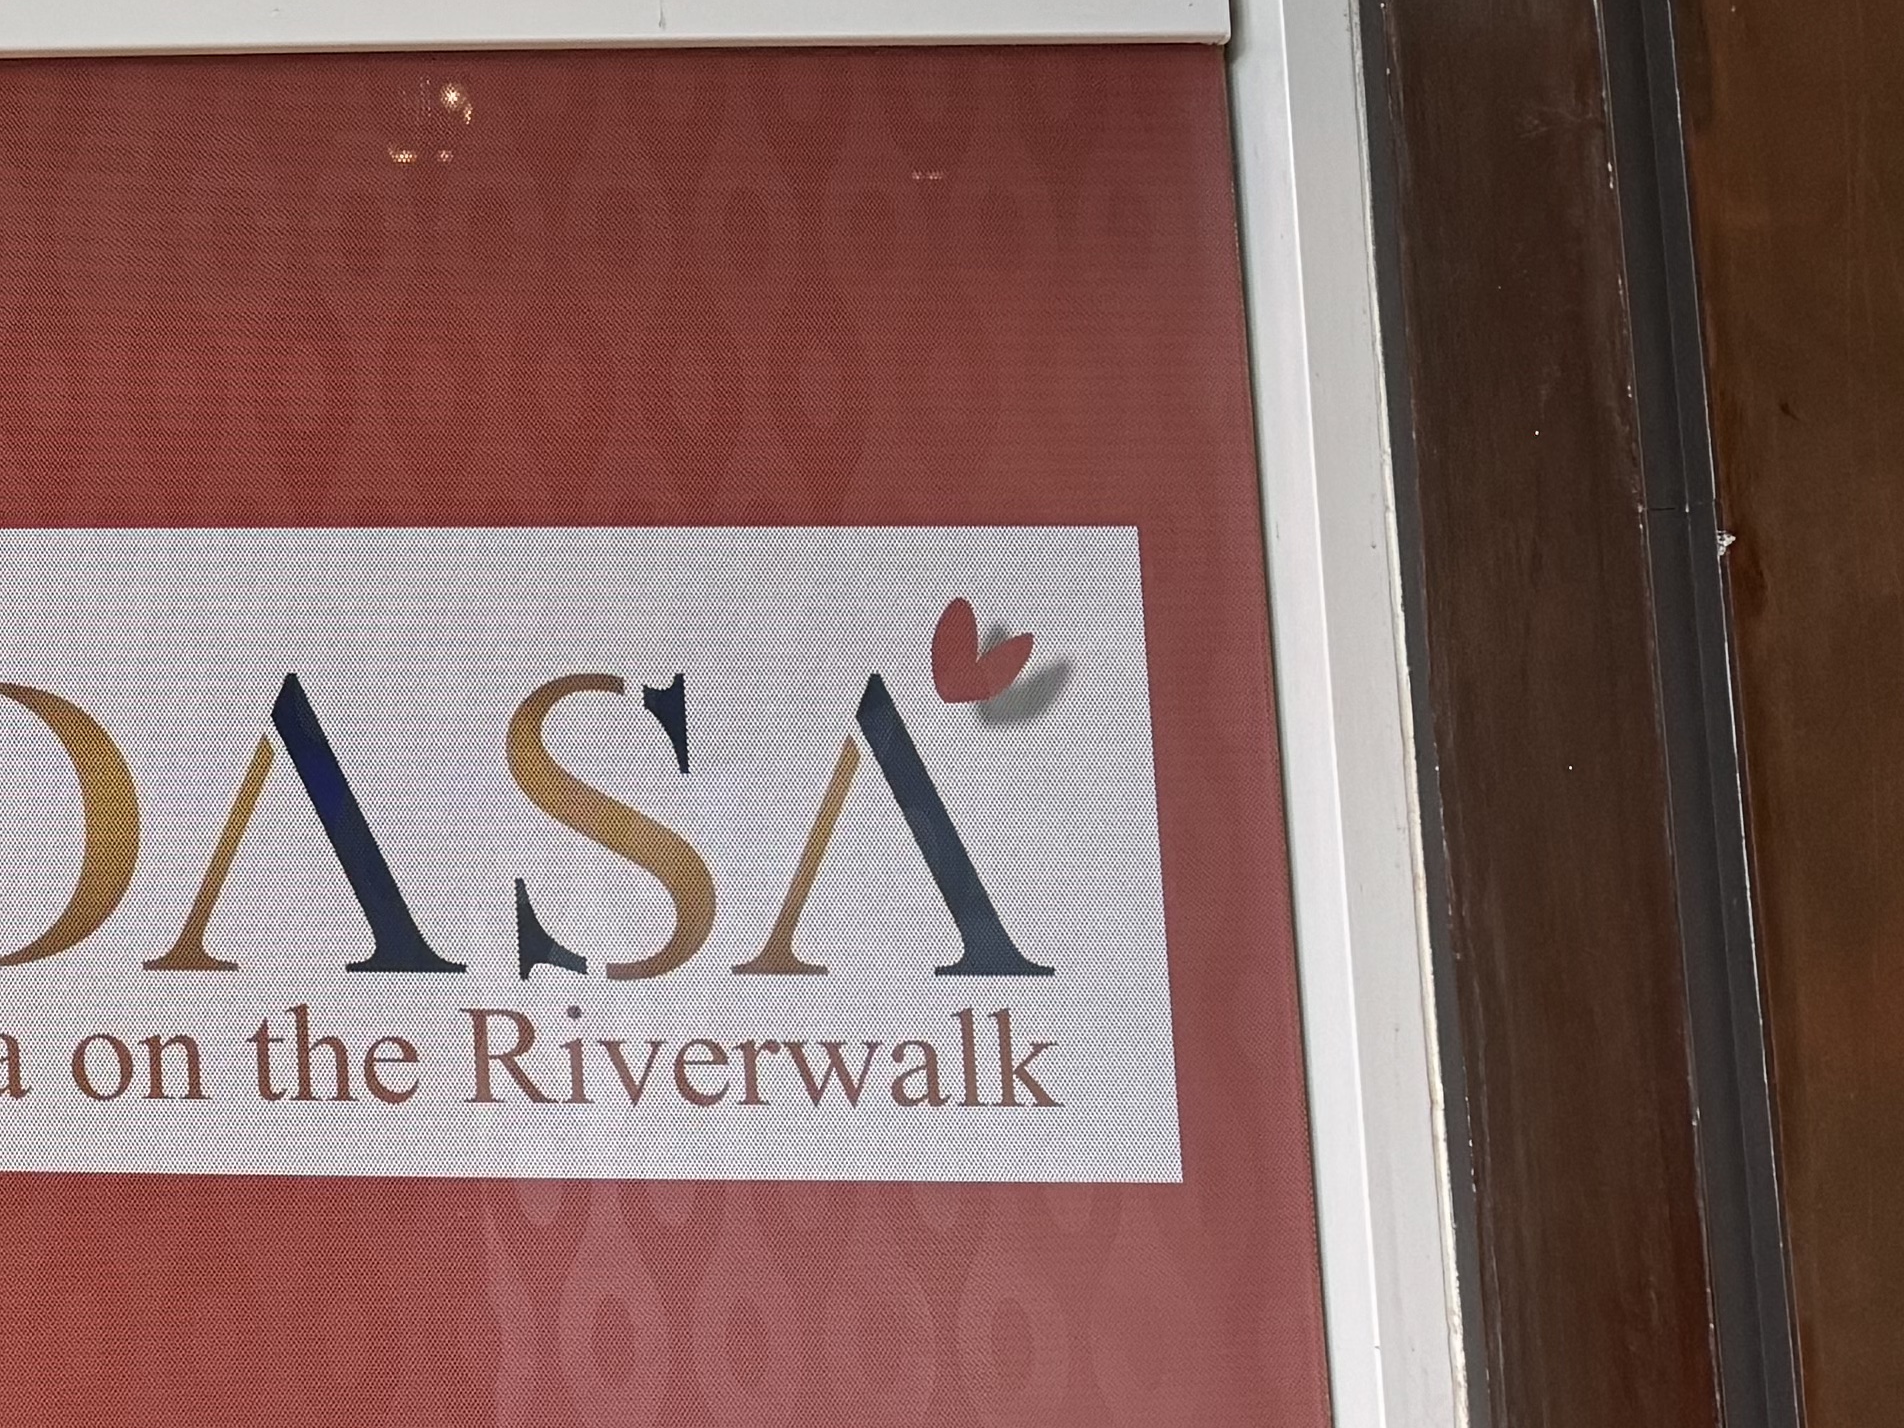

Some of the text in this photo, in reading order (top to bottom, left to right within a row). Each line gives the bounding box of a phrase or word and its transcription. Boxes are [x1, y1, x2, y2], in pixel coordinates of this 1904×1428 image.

[70, 1025, 210, 1101] on
[253, 1003, 420, 1103] the
[459, 1003, 1064, 1109] Riverwalk
